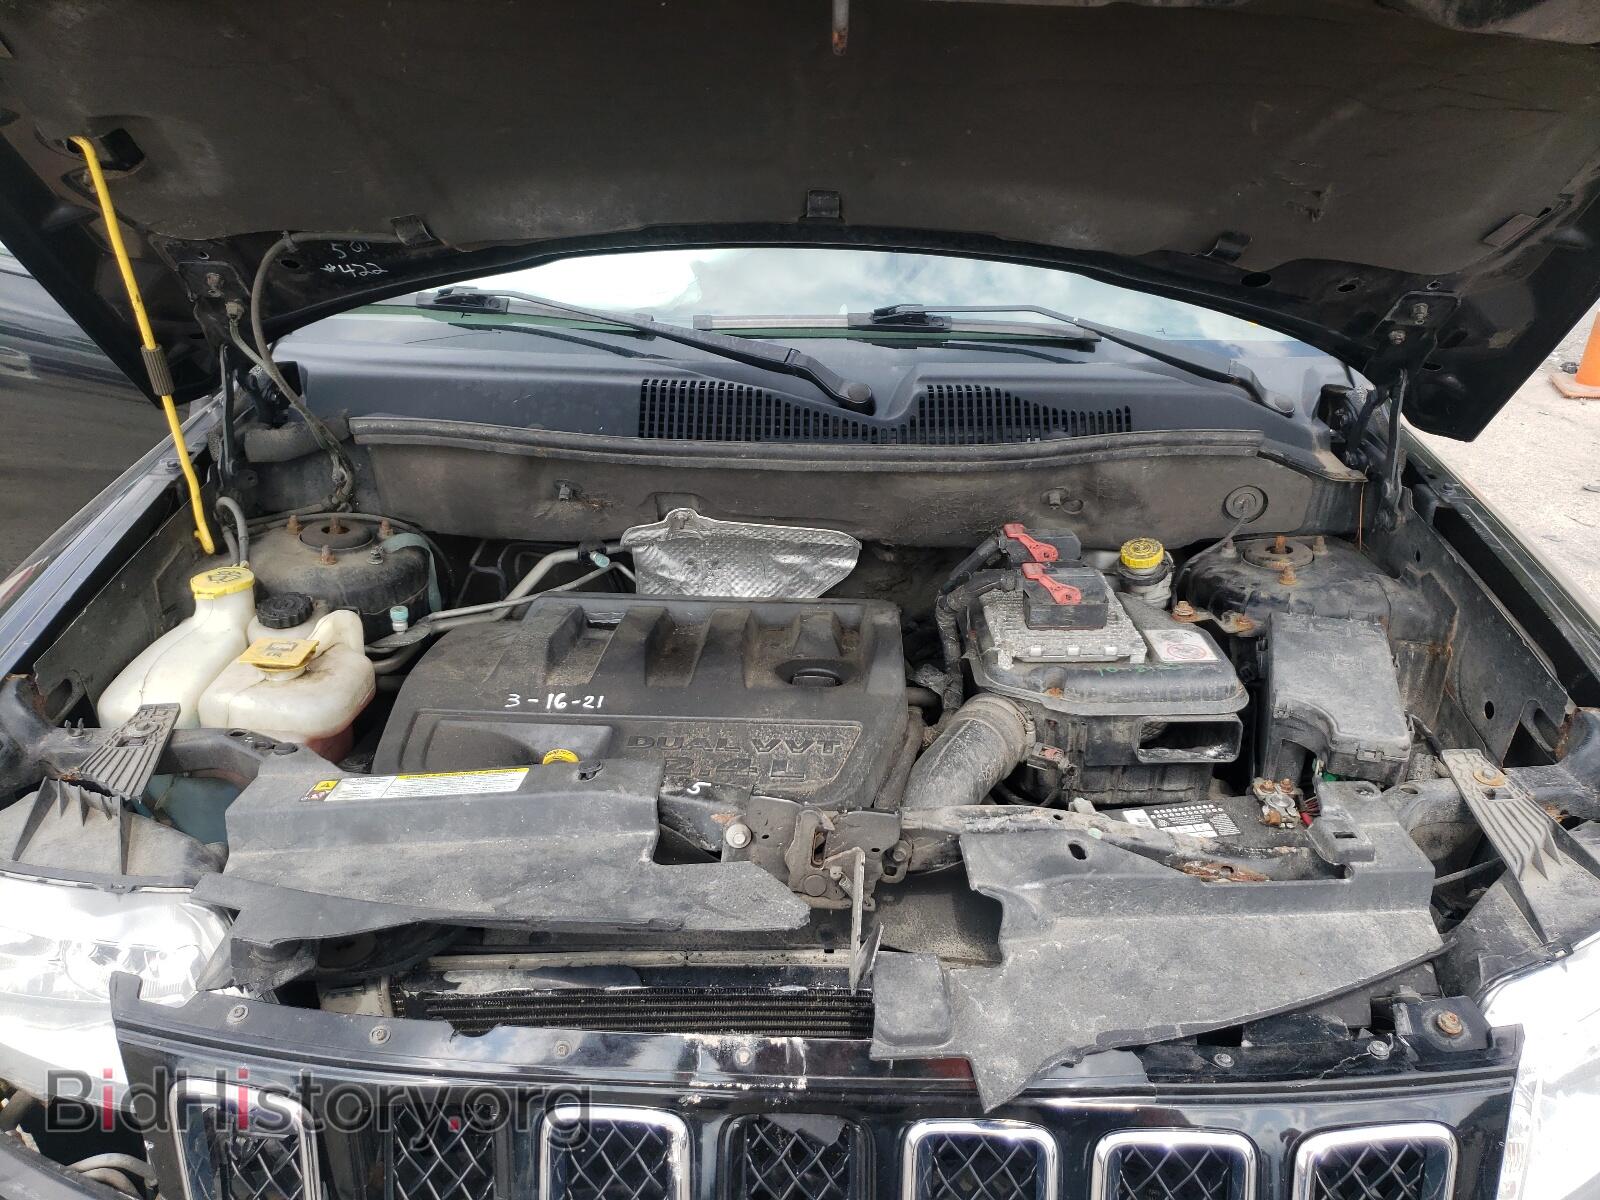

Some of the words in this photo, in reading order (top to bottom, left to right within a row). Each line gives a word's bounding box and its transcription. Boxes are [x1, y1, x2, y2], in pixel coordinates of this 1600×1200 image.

[320, 262, 389, 278] #422
[627, 735, 741, 752] DUAL
[751, 738, 841, 754] VVT
